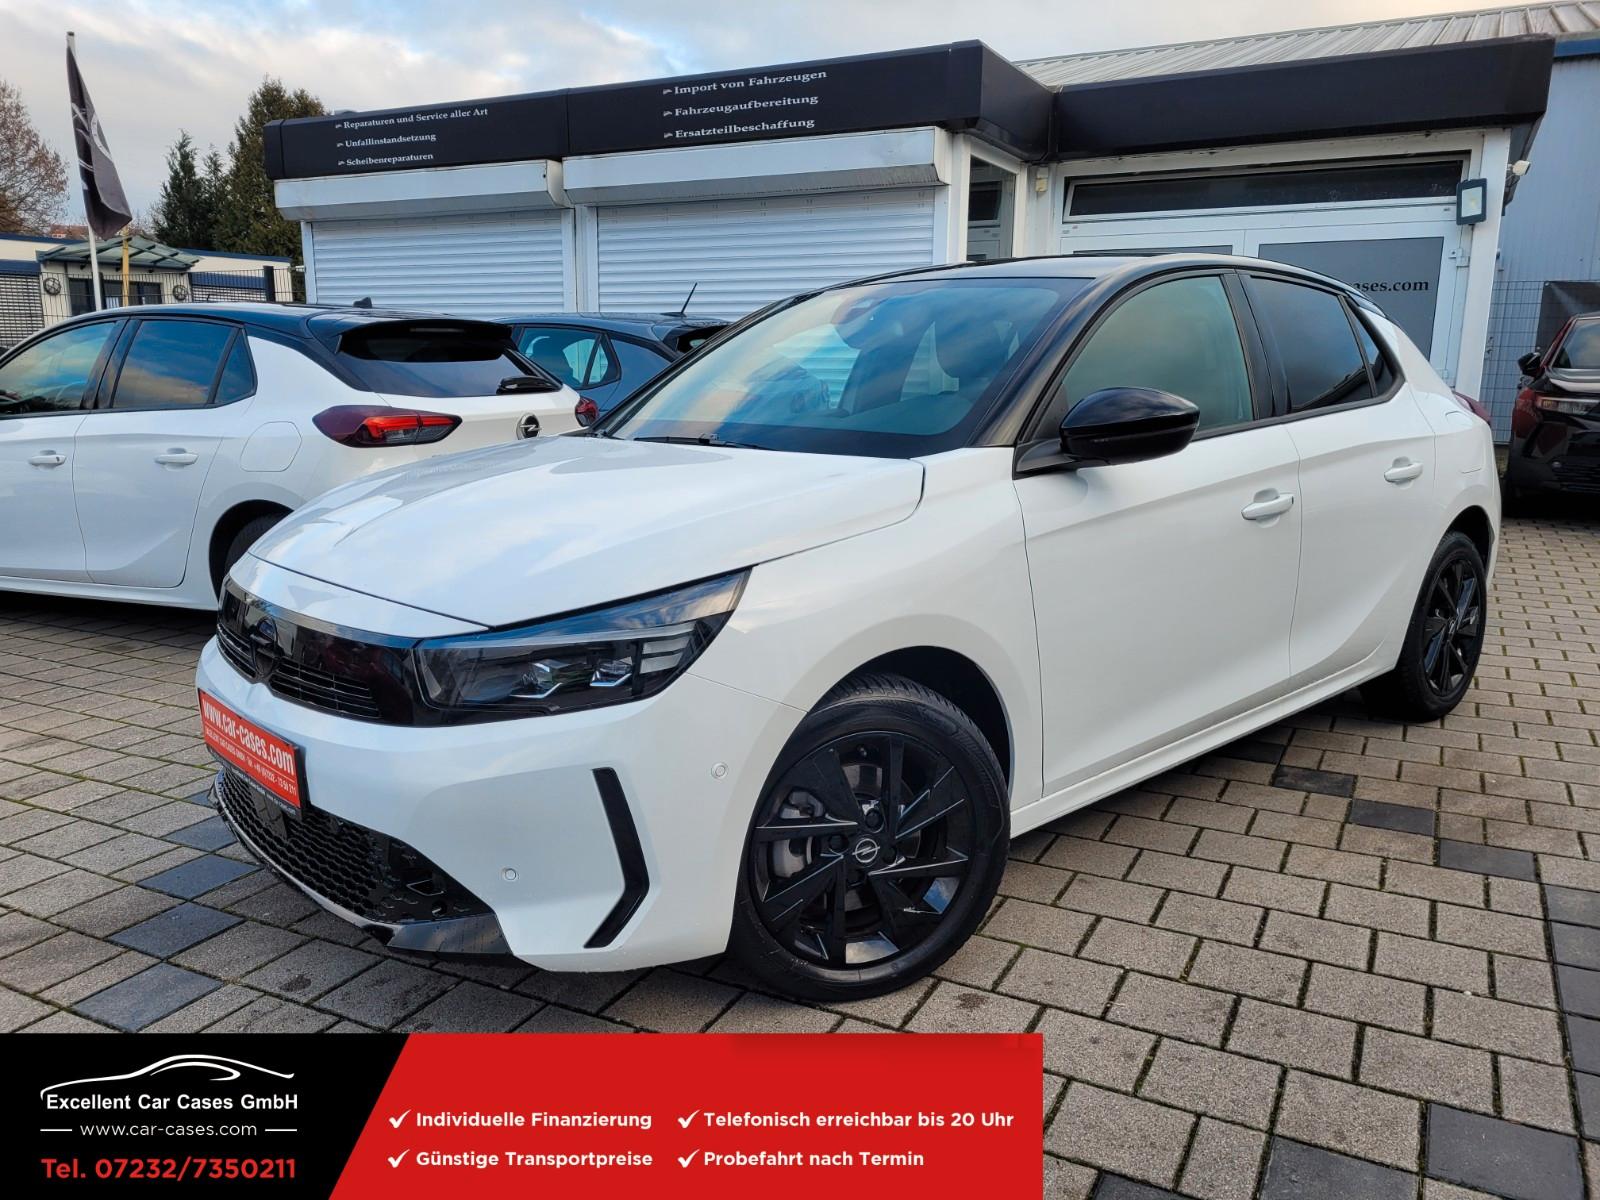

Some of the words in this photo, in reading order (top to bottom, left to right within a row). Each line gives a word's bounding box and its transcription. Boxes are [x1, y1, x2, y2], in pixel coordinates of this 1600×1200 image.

[674, 82, 717, 95] Import
[720, 81, 745, 89] von
[748, 71, 827, 87] Fahrzeugen
[674, 96, 818, 116] Fahrzeugaufbereitung
[343, 117, 395, 130] Reparaturen
[396, 114, 415, 124] und
[415, 113, 449, 122] Service
[450, 110, 471, 119] aller
[473, 107, 489, 116] Art
[675, 119, 815, 138] Ersatzteilbeschaffung
[345, 133, 437, 148] Unfallinstandsetzung
[346, 153, 434, 167] Scheibenreparaturen
[202, 698, 295, 775] www.car-cases.com
